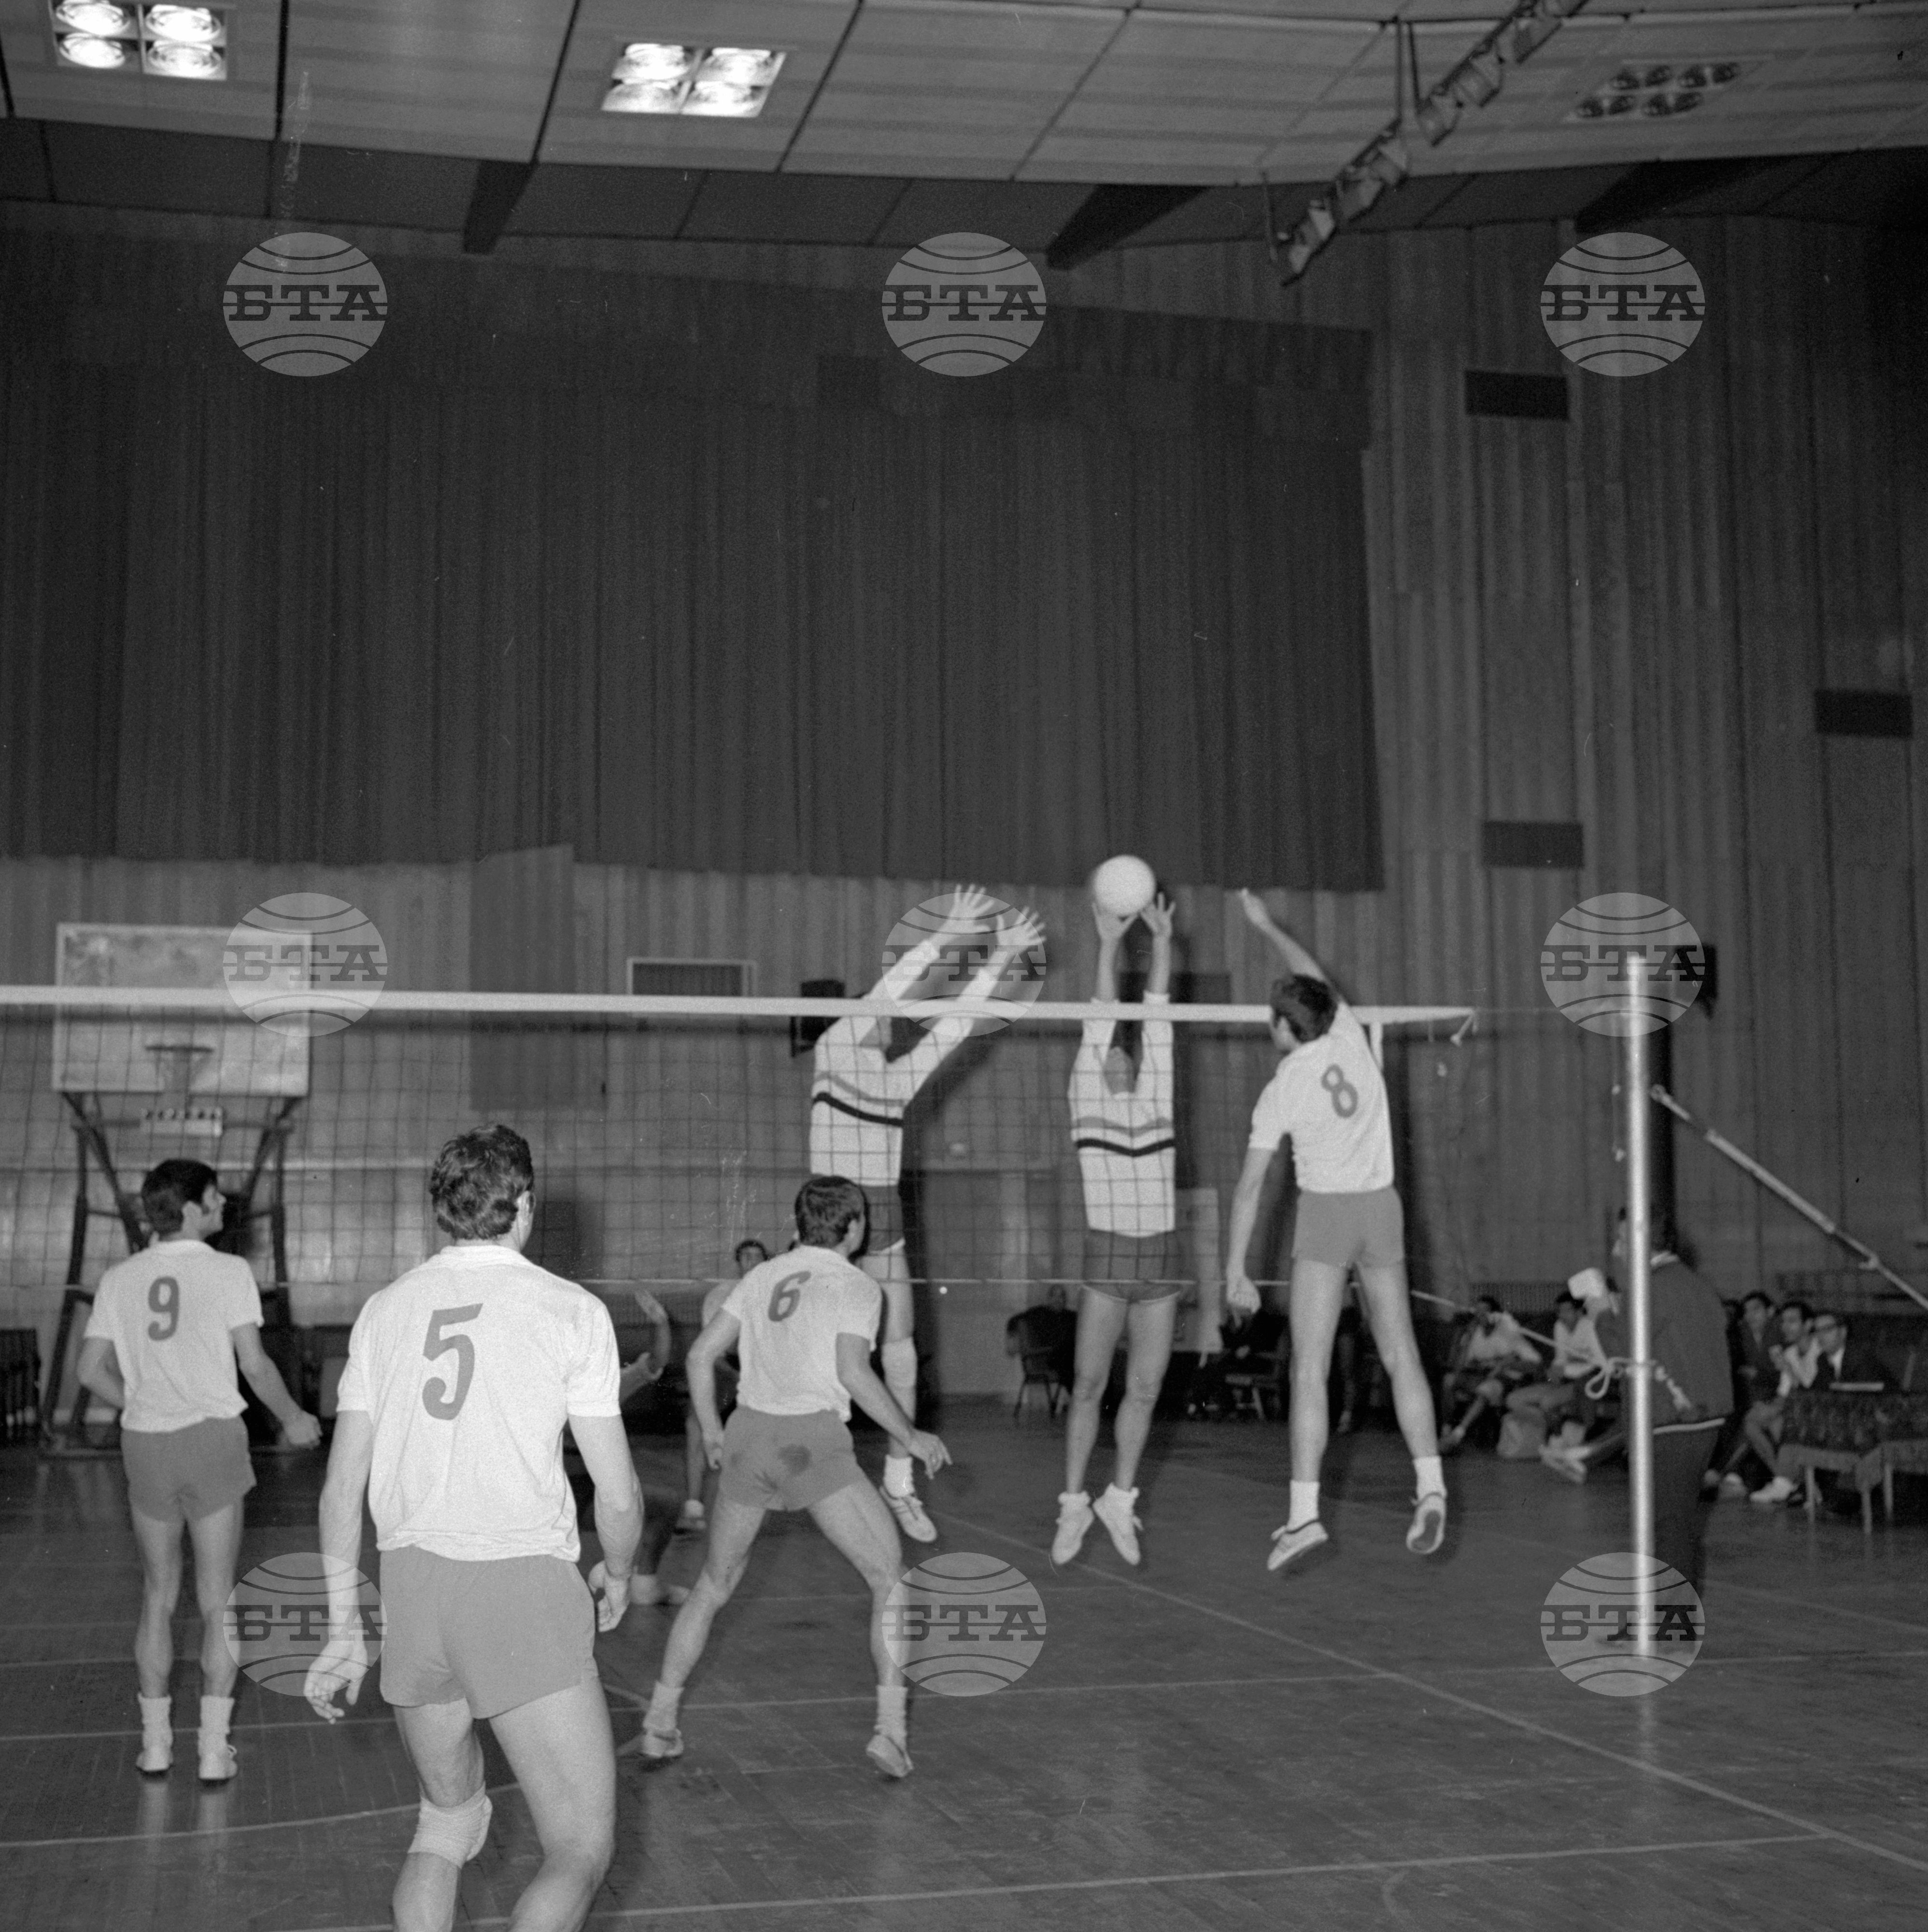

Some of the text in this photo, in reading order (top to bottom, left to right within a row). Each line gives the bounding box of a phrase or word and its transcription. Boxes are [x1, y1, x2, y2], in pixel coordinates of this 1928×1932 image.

[1320, 1064, 1358, 1118] 8
[148, 1276, 180, 1341] 9
[768, 1271, 811, 1322] 6
[422, 1304, 482, 1421] 5
